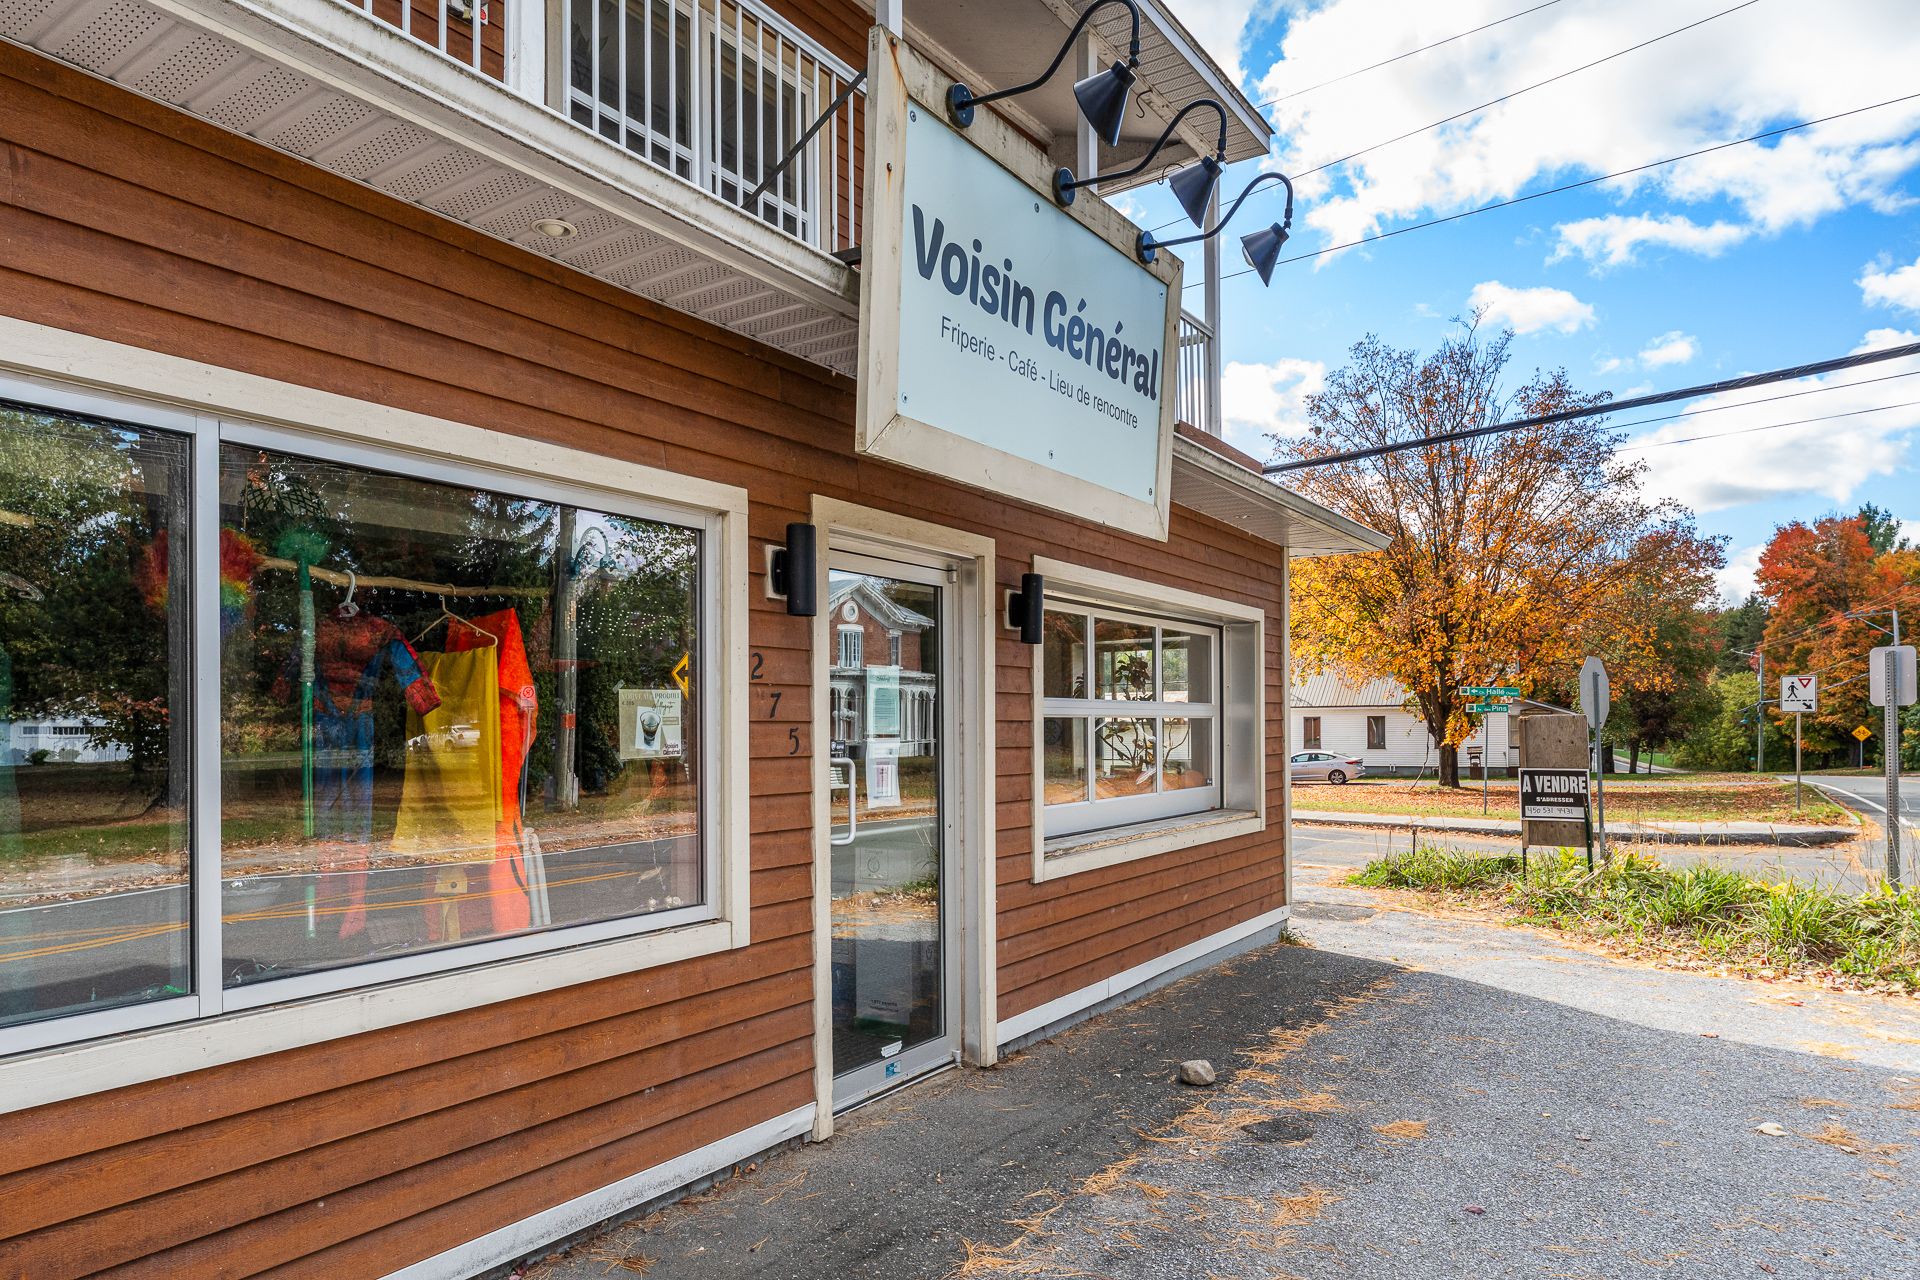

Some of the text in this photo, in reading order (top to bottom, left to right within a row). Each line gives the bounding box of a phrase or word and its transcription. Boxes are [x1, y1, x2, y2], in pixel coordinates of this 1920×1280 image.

[911, 203, 1159, 401] Voisin Général
[941, 315, 995, 361] Friperie
[1008, 350, 1038, 382] Café
[1049, 369, 1074, 399] Lieu
[1076, 384, 1090, 406] de
[1093, 394, 1138, 429] rencontre
[1526, 806, 1541, 815] 450
[1534, 775, 1587, 794] VENDRE
